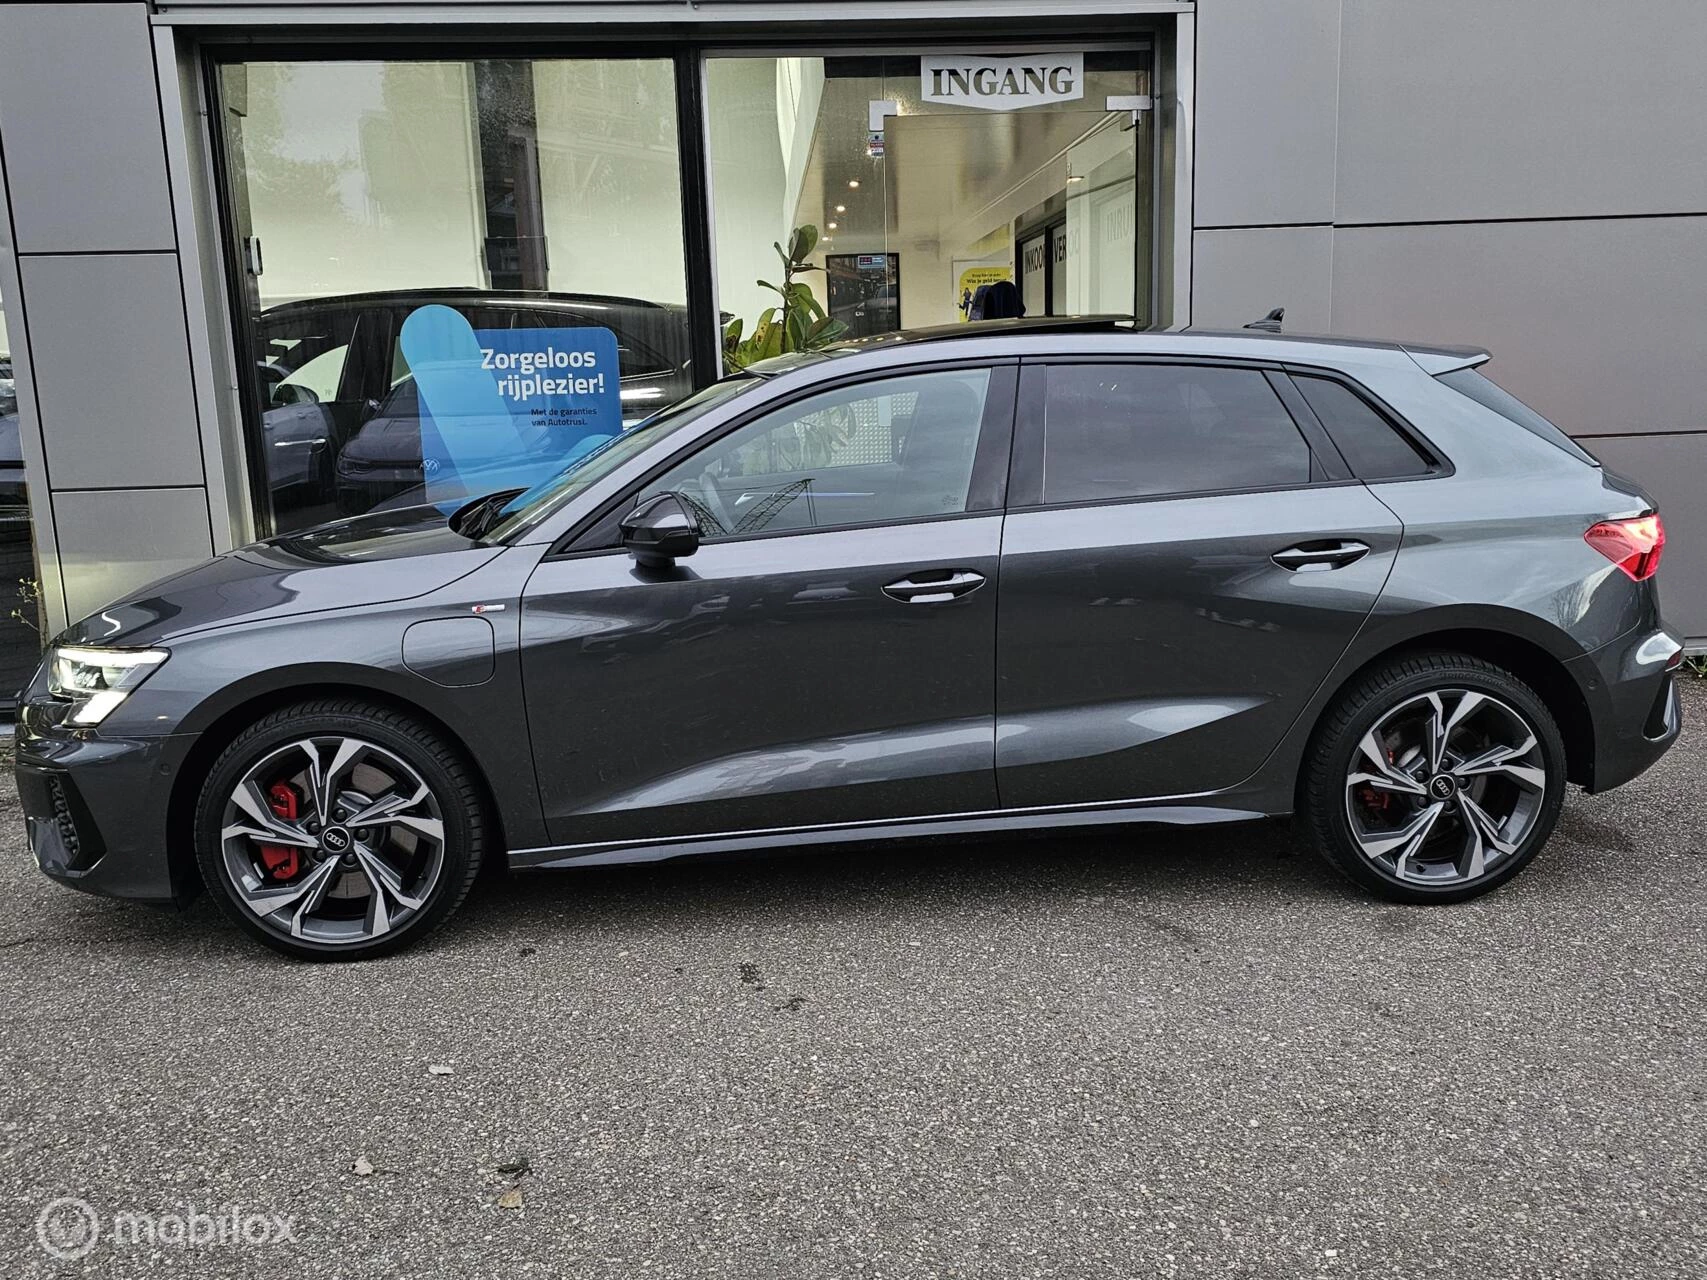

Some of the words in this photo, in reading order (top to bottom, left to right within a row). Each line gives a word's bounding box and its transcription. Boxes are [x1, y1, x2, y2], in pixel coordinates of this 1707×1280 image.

[930, 66, 1074, 97] INGANG
[480, 347, 596, 375] Zorgeloos
[497, 373, 605, 401] rijplezier!
[531, 408, 547, 416] Met
[549, 408, 558, 416] de
[560, 407, 598, 417] garanties
